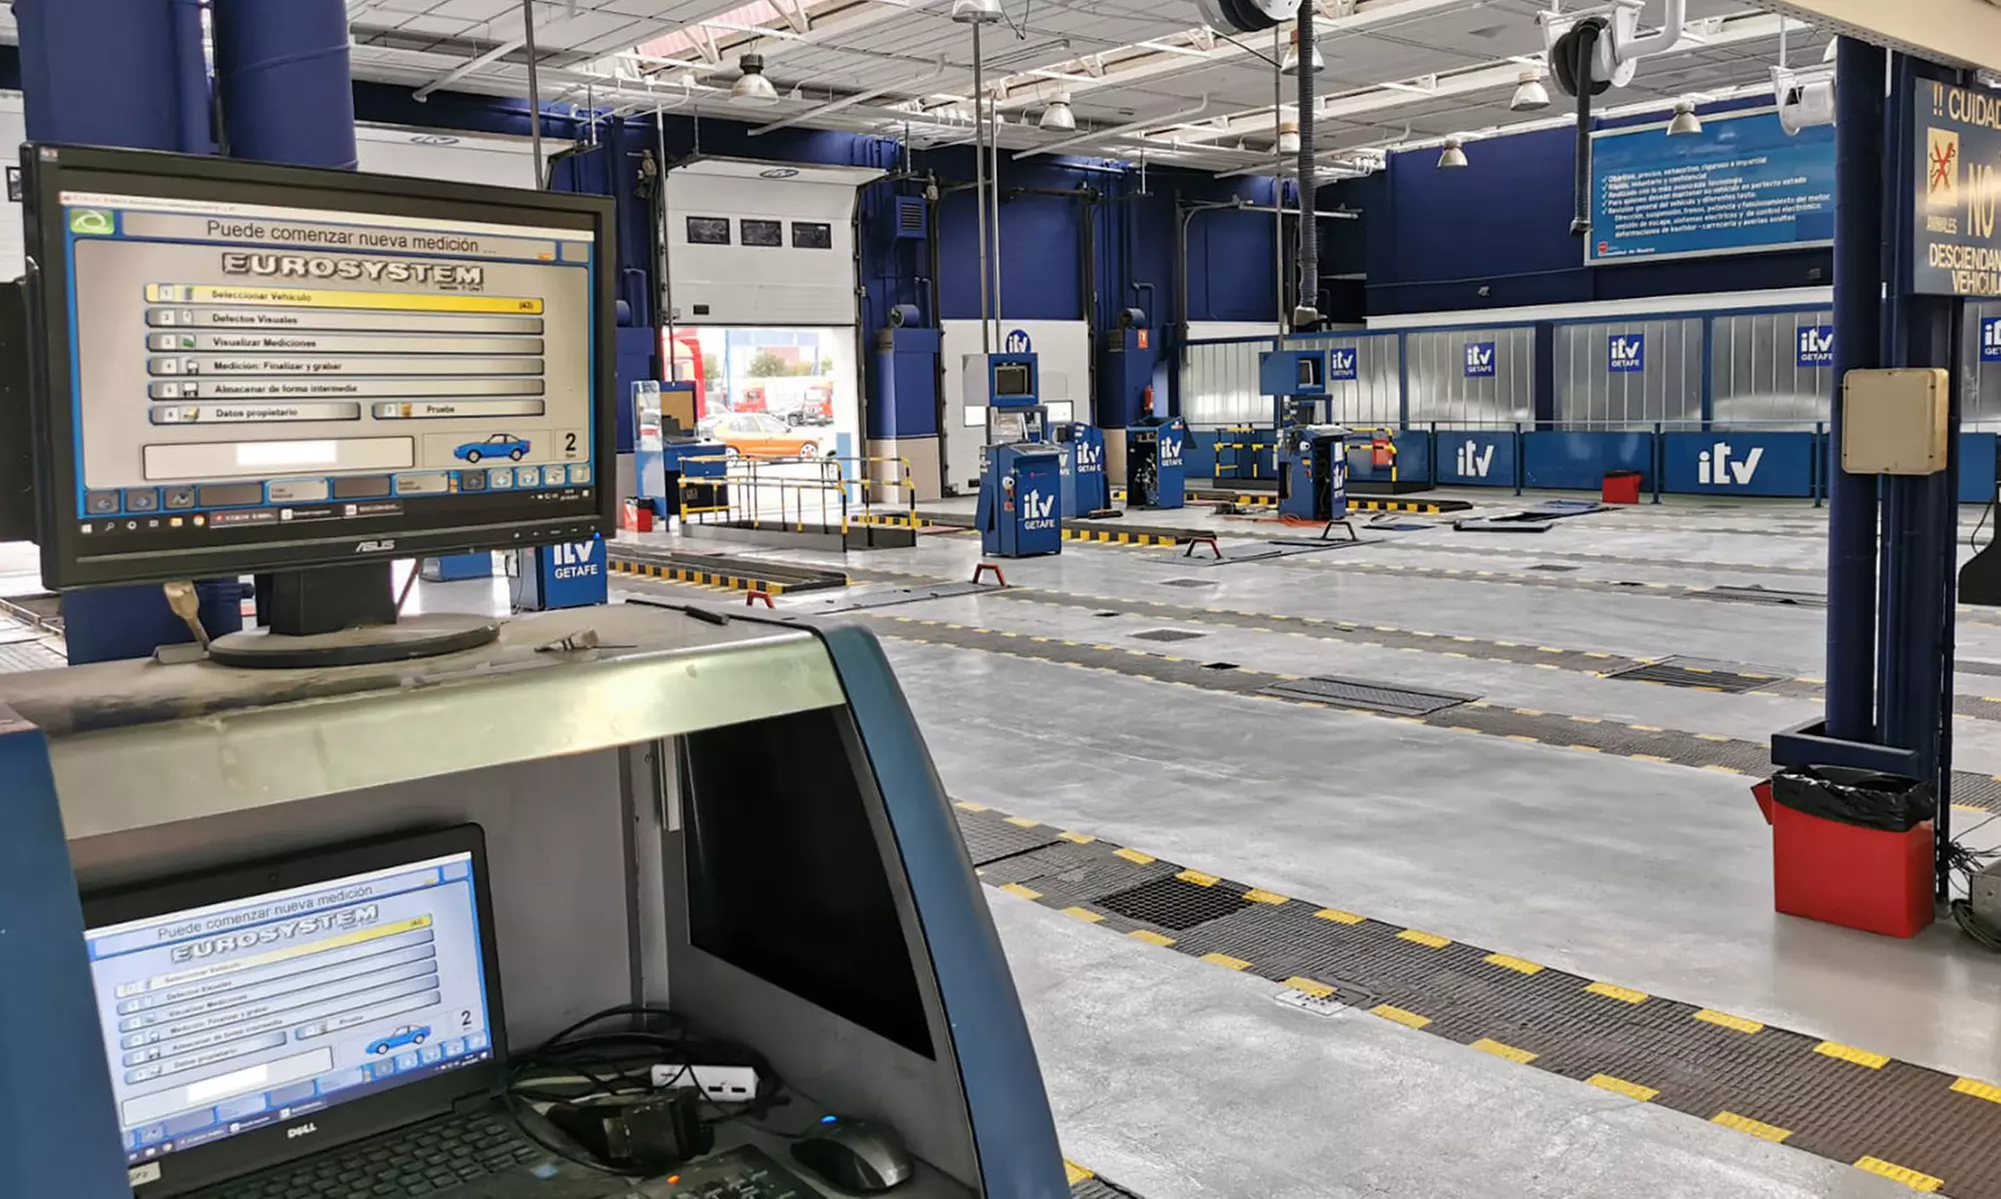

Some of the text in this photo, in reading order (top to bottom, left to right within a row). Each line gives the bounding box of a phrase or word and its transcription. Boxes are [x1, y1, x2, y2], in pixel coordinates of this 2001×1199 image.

[1967, 162, 1996, 239] NO
[207, 220, 479, 254] Puede comenzar nueva medición
[222, 252, 484, 285] EUROSYSTEM
[212, 289, 268, 301] Seleccionar
[212, 313, 255, 325] Defectos
[257, 314, 298, 325] Visuales
[213, 337, 260, 348] Visualizar
[263, 338, 317, 349] Mediciones
[263, 360, 304, 371] Finalizar
[1467, 365, 1492, 373] GETAFE
[1611, 359, 1640, 368] GETAFE
[215, 384, 266, 394] Almacenar
[268, 384, 280, 394] de
[281, 384, 309, 394] forma
[310, 384, 358, 394] intermedia
[215, 408, 245, 419] Datos
[246, 408, 298, 421] propietario
[426, 405, 455, 415] Prueba
[565, 432, 577, 452] 2
[1024, 519, 1056, 530] GETAFE
[355, 539, 395, 554] ASUS
[554, 563, 599, 579] GETAFE
[158, 884, 373, 941] Puede comenzar nueva medición
[171, 903, 379, 964] EUROSYSTEM
[460, 1009, 472, 1026] 2
[287, 1122, 317, 1139] DELL
